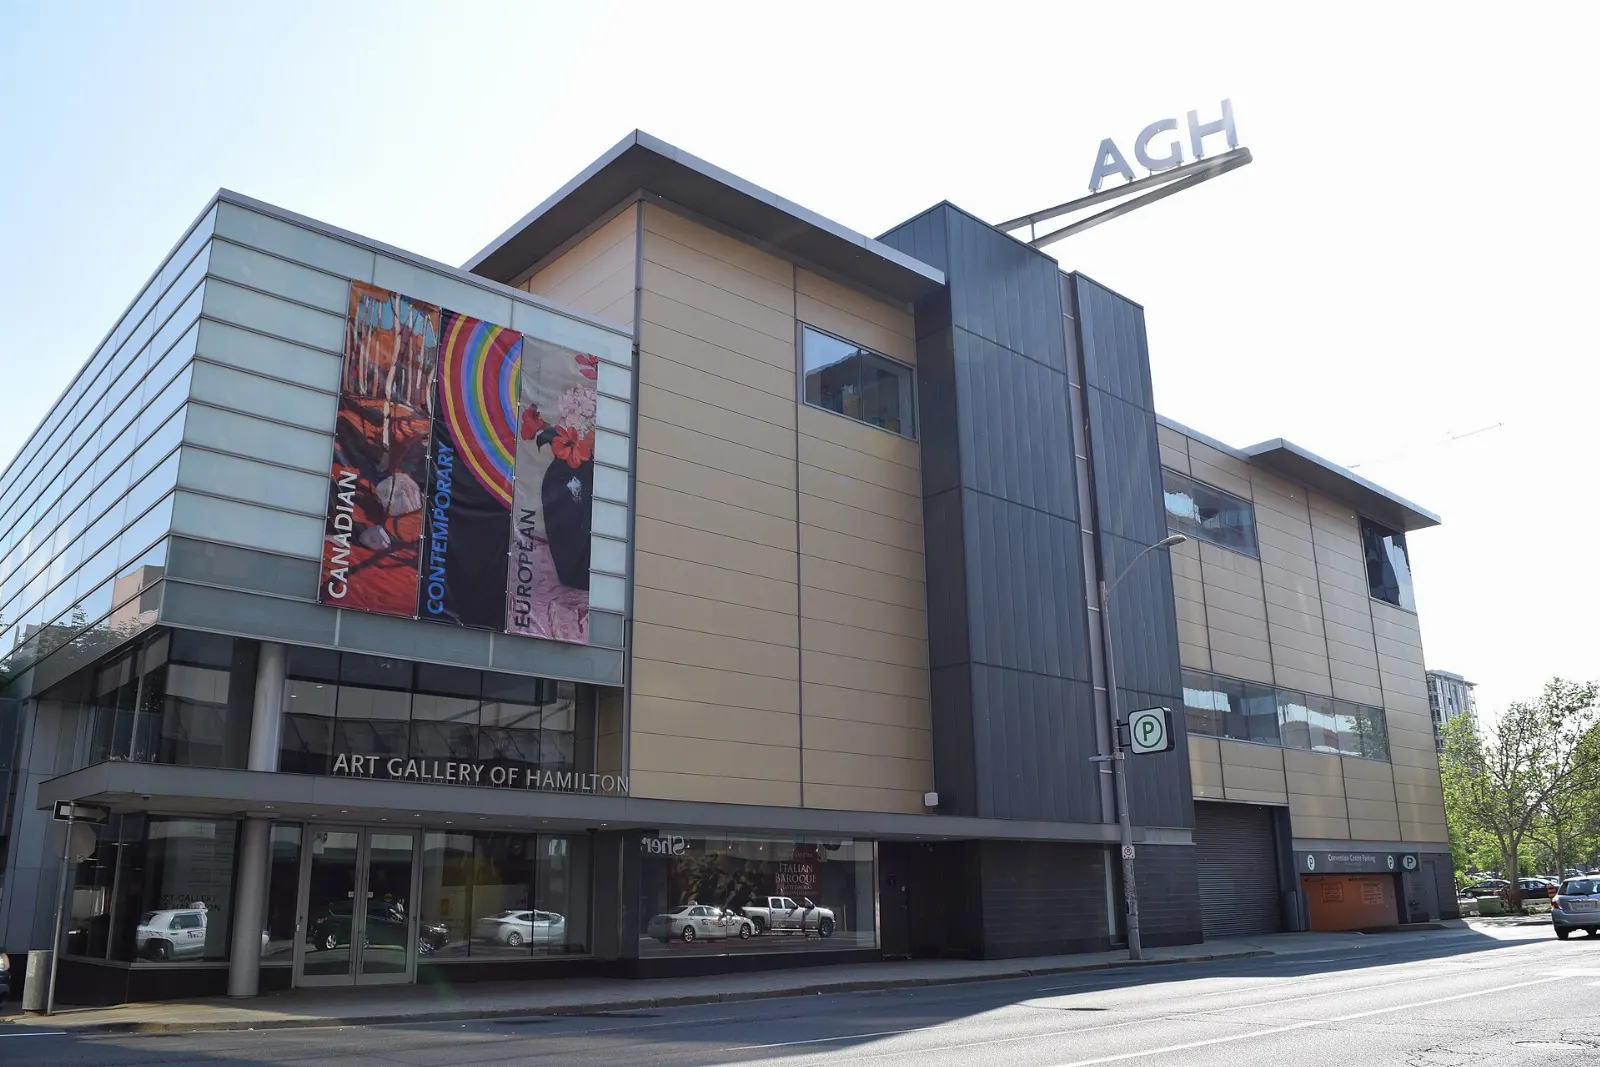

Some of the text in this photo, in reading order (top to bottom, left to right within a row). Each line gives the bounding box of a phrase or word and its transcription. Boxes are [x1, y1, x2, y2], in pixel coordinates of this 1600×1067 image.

[1088, 98, 1240, 193] AGH
[328, 470, 359, 599] CANADIAN
[426, 440, 455, 615] CONTEMPORARY
[513, 508, 537, 629] EUROPEAN
[333, 753, 630, 793] ART GALLERY OF HAMILTON
[177, 894, 218, 903] GALLERY
[775, 872, 817, 886] BAROQUE
[779, 862, 813, 873] ITALIAN
